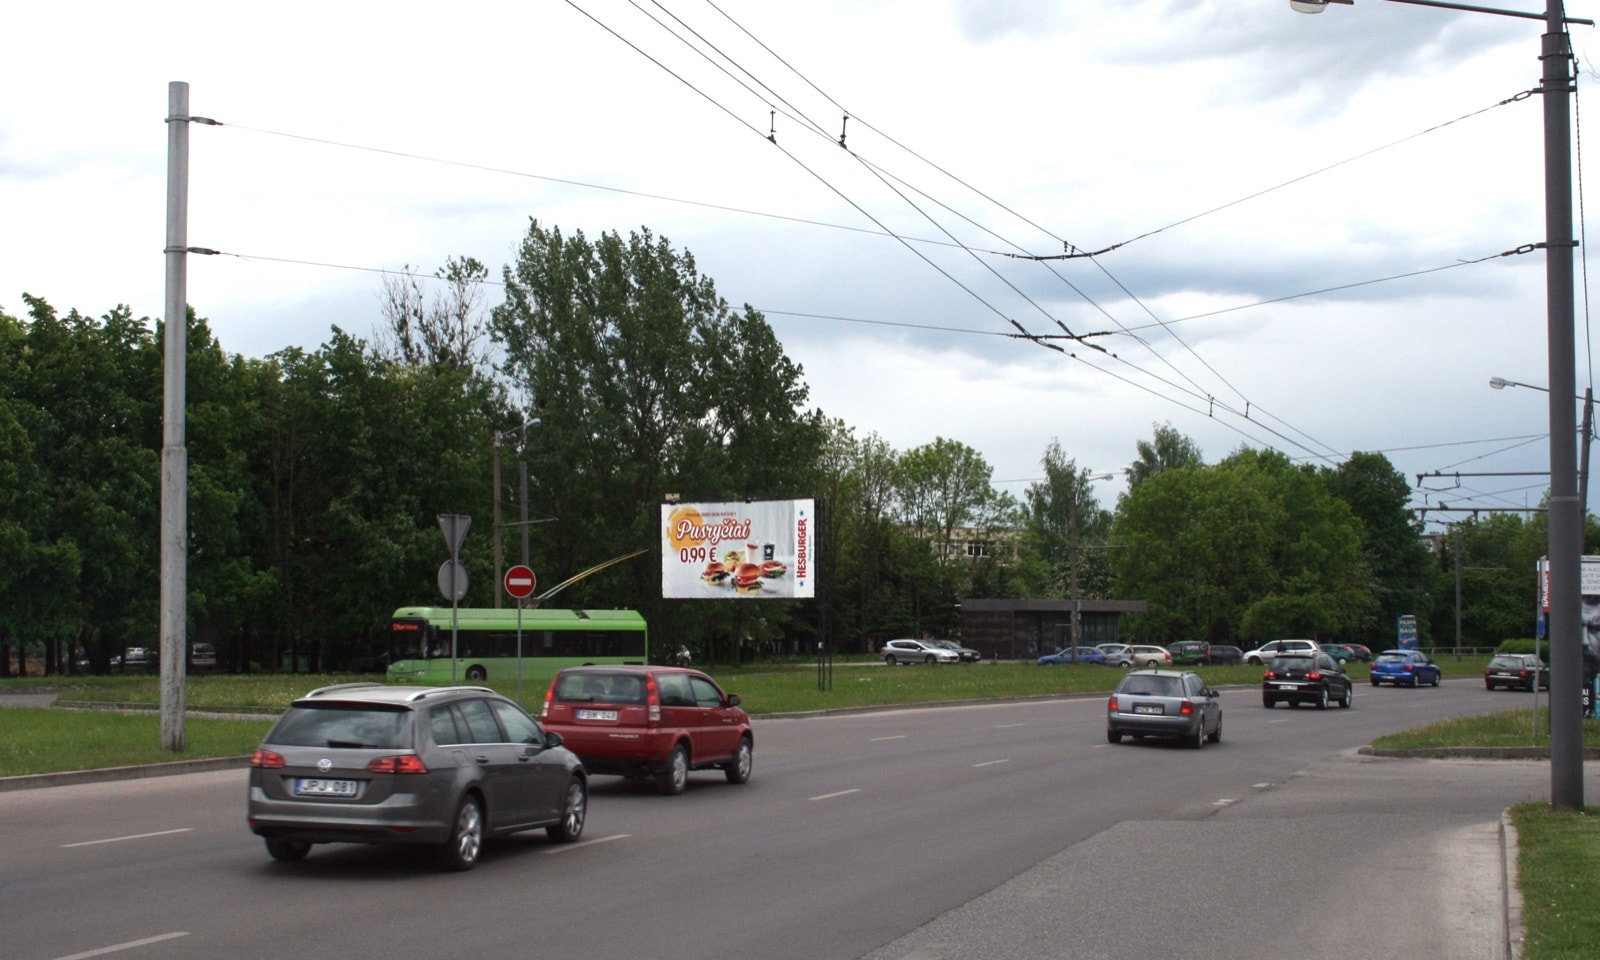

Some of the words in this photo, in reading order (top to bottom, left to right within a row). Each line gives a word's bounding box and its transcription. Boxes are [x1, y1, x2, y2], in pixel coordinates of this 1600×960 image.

[676, 518, 751, 545] Pusryčiai
[680, 547, 706, 564] 0,99
[709, 547, 717, 563] €
[796, 518, 807, 578] HESBURGER
[302, 780, 328, 791] JPJ
[333, 781, 355, 792] 081
